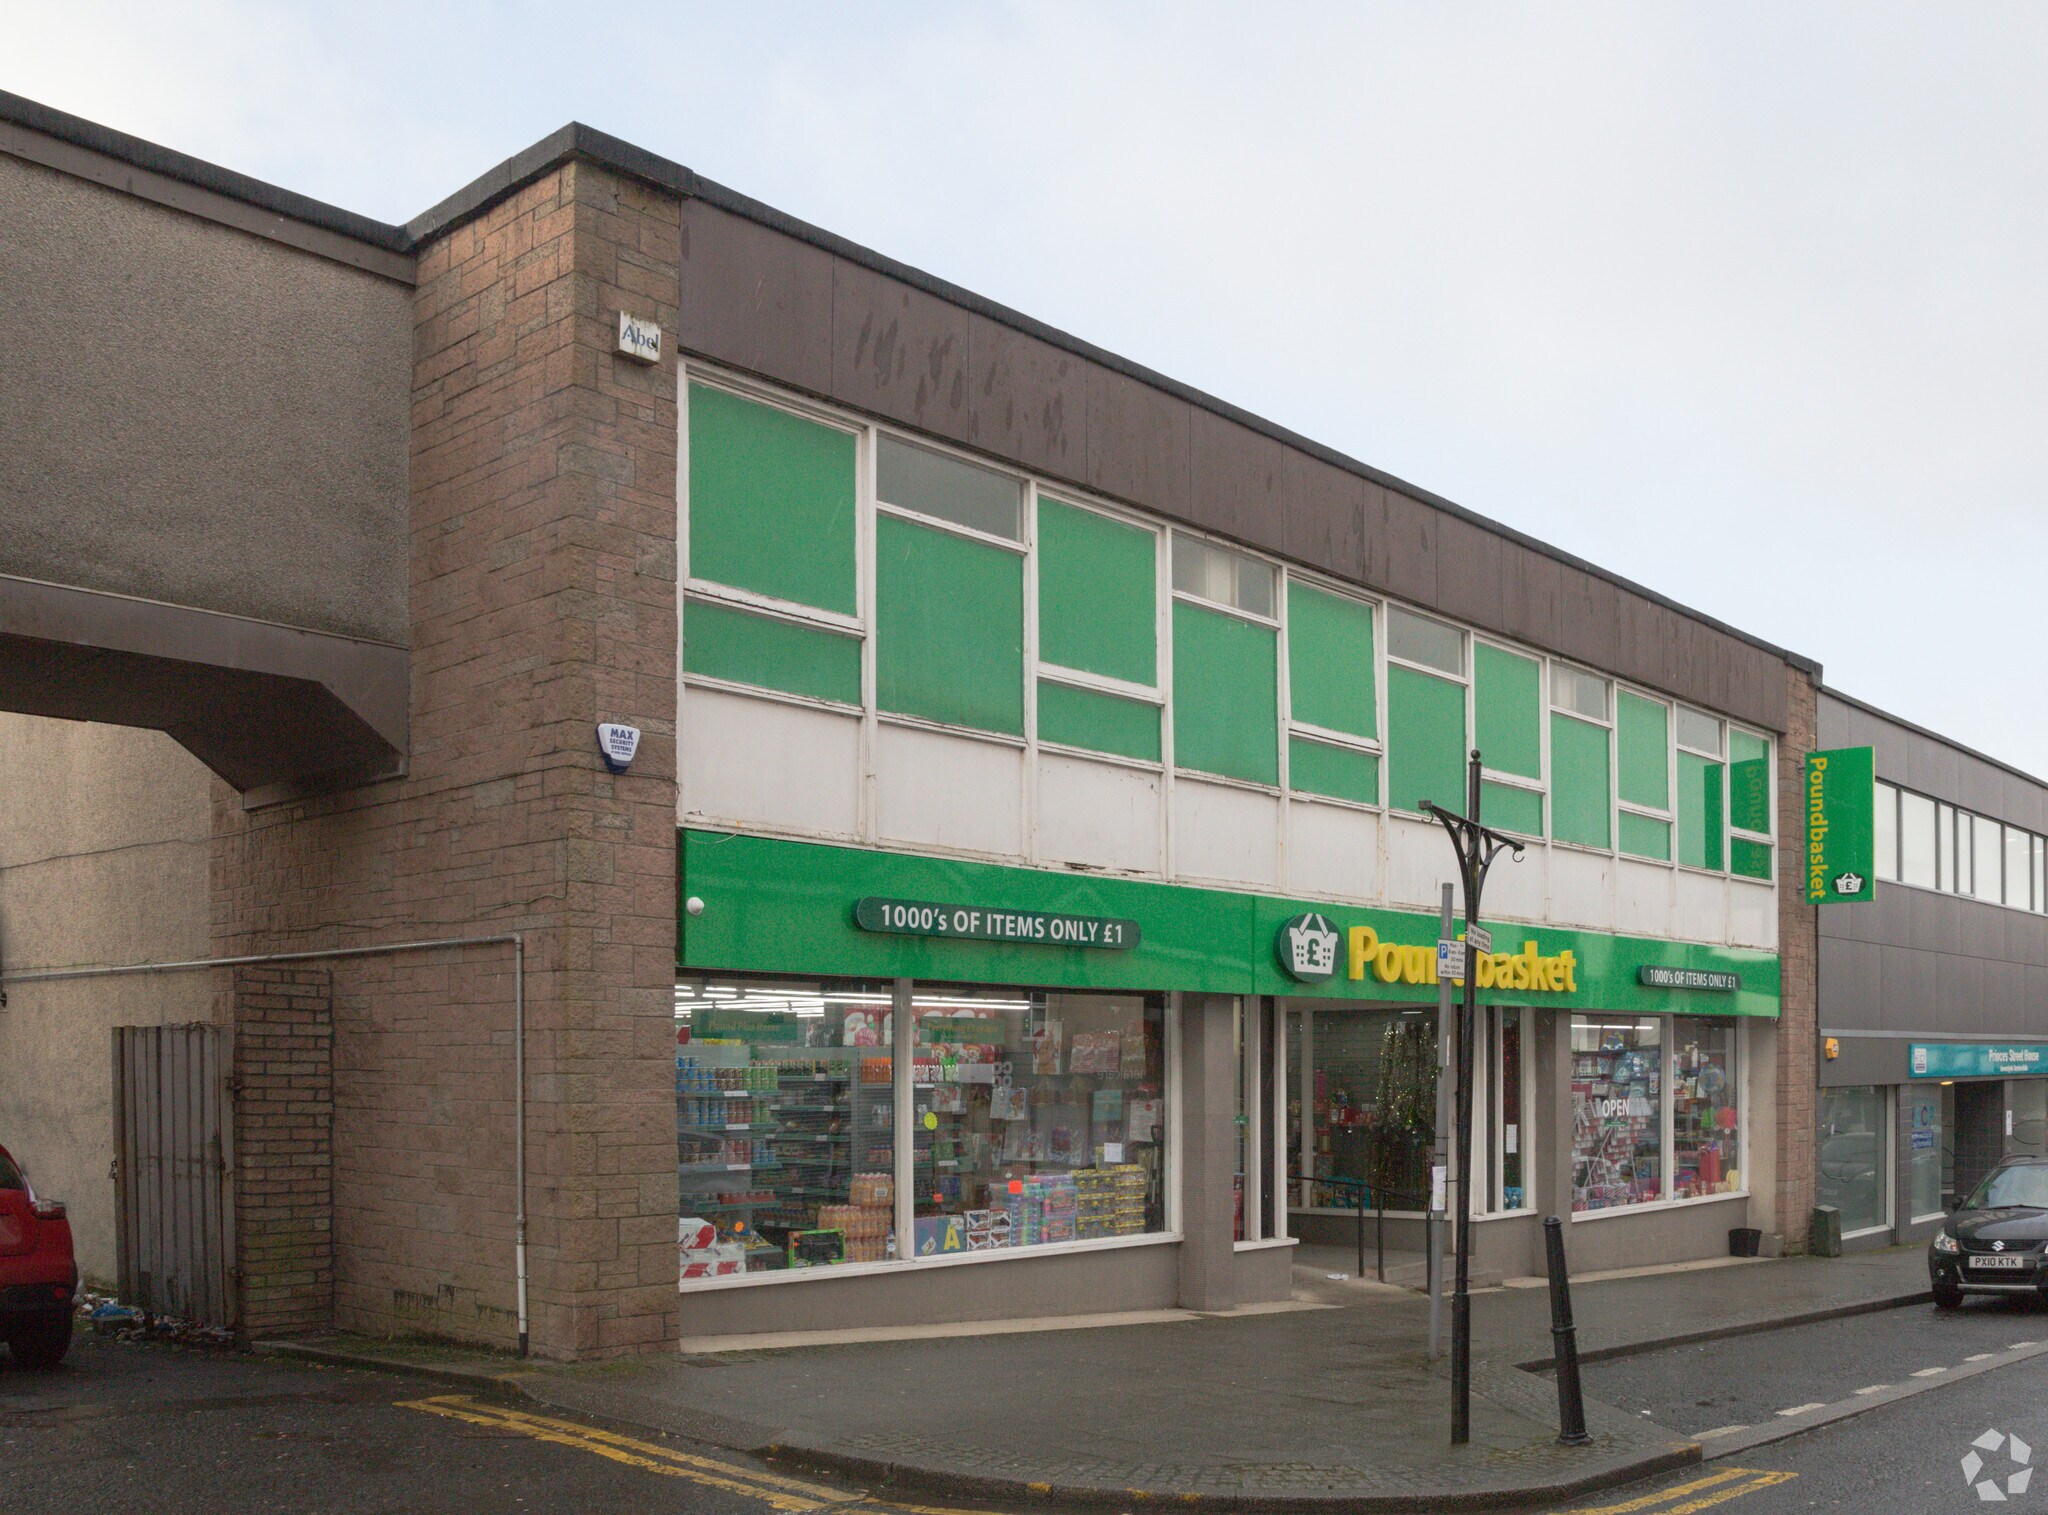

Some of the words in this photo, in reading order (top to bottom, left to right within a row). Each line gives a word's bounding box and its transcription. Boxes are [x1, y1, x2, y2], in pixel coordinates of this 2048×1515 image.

[622, 324, 659, 352] Abel
[609, 738, 634, 746] SECURITY
[610, 728, 634, 741] MAX
[1810, 757, 1829, 899] Poundbasket
[953, 910, 981, 933] OF
[986, 913, 1045, 938] ITEMS
[1050, 919, 1098, 942] ONLY
[1103, 924, 1123, 944] £1
[1349, 925, 1577, 993] Poubasket
[1674, 971, 1685, 984] OF
[1686, 972, 1708, 986] ITEMS
[1708, 974, 1727, 988] ONLY
[1727, 976, 1736, 988] £1
[1988, 1049, 2008, 1062] Princes
[1602, 1099, 1630, 1117] OPEN
[1998, 1257, 2017, 1267] KTK
